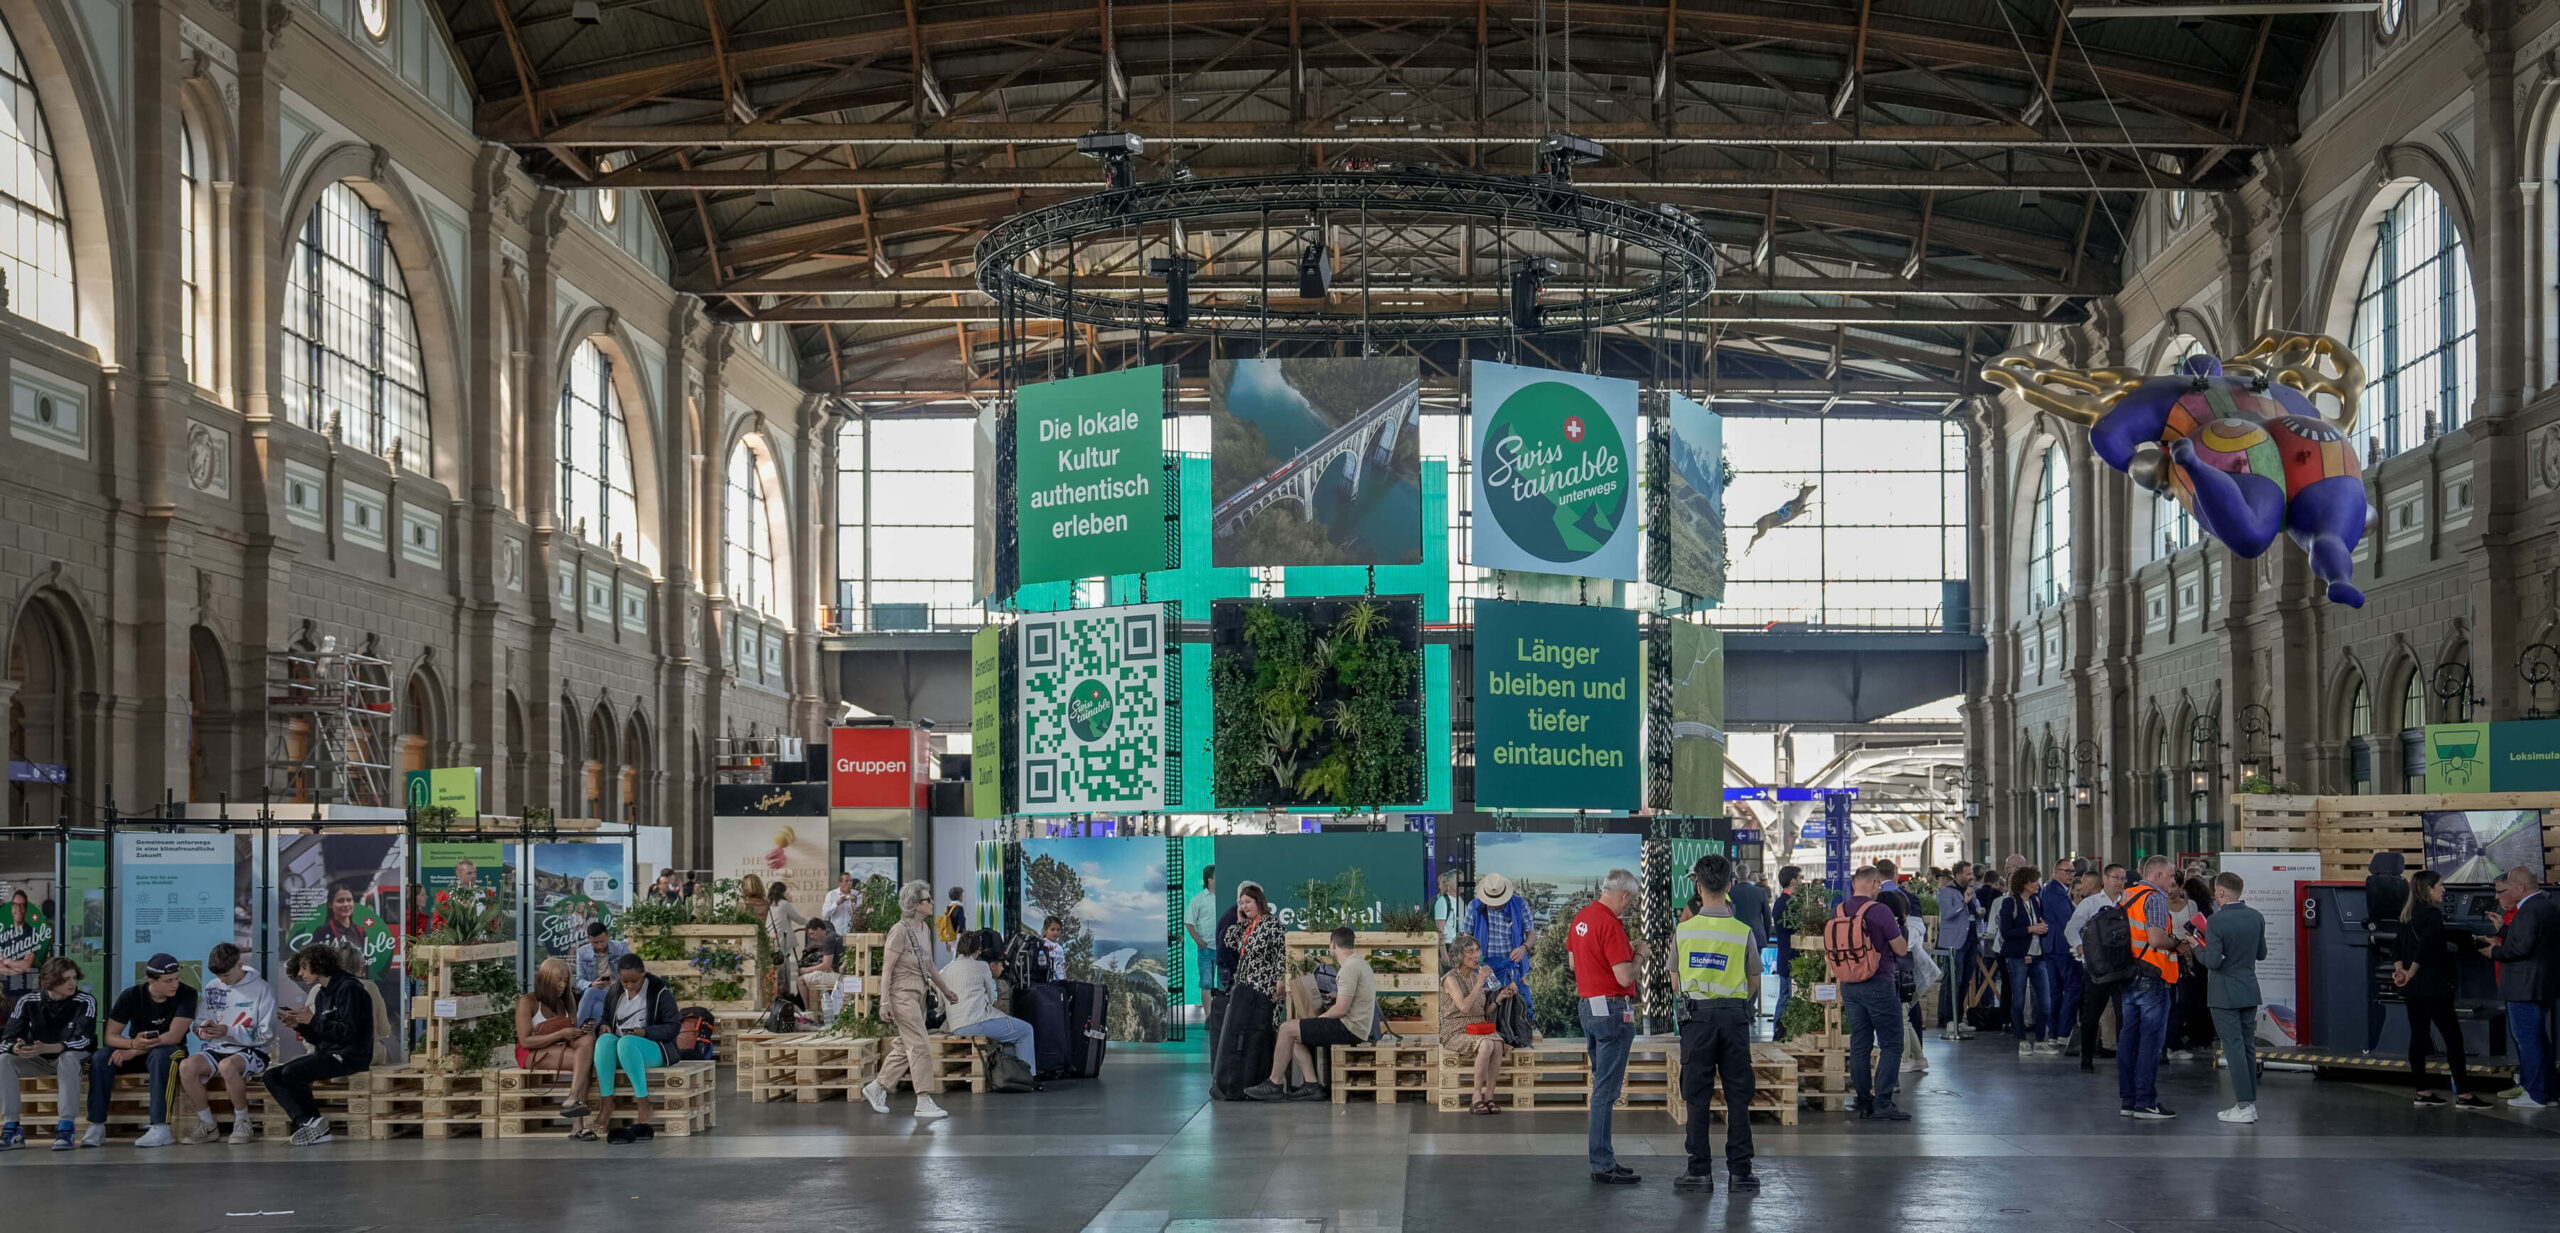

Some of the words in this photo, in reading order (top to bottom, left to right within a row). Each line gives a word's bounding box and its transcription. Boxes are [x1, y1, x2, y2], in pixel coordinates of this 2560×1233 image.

[1039, 418, 1072, 442] Die
[1078, 409, 1139, 437] lokale
[1058, 446, 1120, 473] Kultur
[1488, 435, 1563, 487] Swiss
[1511, 445, 1619, 502] tainable
[1030, 473, 1149, 509] authentisch
[1559, 480, 1617, 506] unterwegs
[1052, 513, 1128, 539] erleben
[1518, 638, 1600, 669] Länger
[1489, 671, 1575, 698] bleiben
[1583, 678, 1626, 700] und
[1070, 700, 1093, 719] Swiss
[1076, 698, 1111, 723] tainable
[1527, 707, 1590, 732] tiefer
[836, 758, 906, 775] Gruppen
[1493, 740, 1623, 767] eintauchen
[1813, 792, 1822, 800] 41
[742, 857, 764, 865] DIE
[1264, 901, 1382, 930] egional
[0, 923, 24, 944] wiss
[552, 913, 618, 948] tainle
[1691, 956, 1726, 967] Sicherheit
